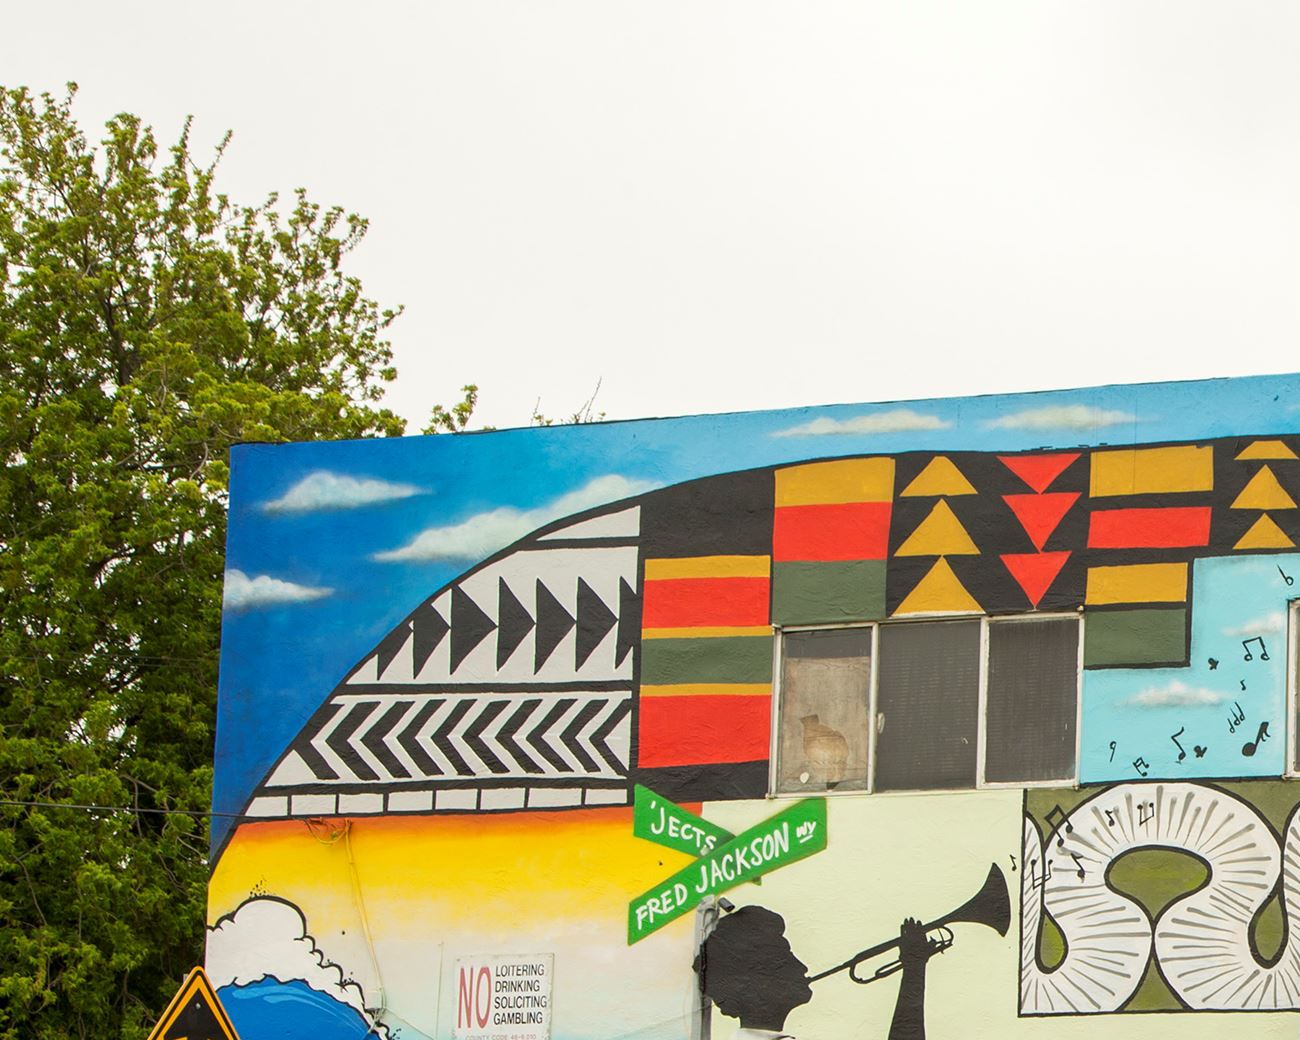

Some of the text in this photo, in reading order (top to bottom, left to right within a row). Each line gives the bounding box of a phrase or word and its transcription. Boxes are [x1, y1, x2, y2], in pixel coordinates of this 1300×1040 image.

[636, 883, 688, 930] FRED
[696, 822, 789, 894] JACKSON
[495, 964, 545, 977] LOITERING
[495, 980, 540, 993] DRINKING
[457, 966, 492, 1029] NO
[494, 996, 547, 1009] SOLICITING
[493, 1011, 543, 1025] GAMBLING
